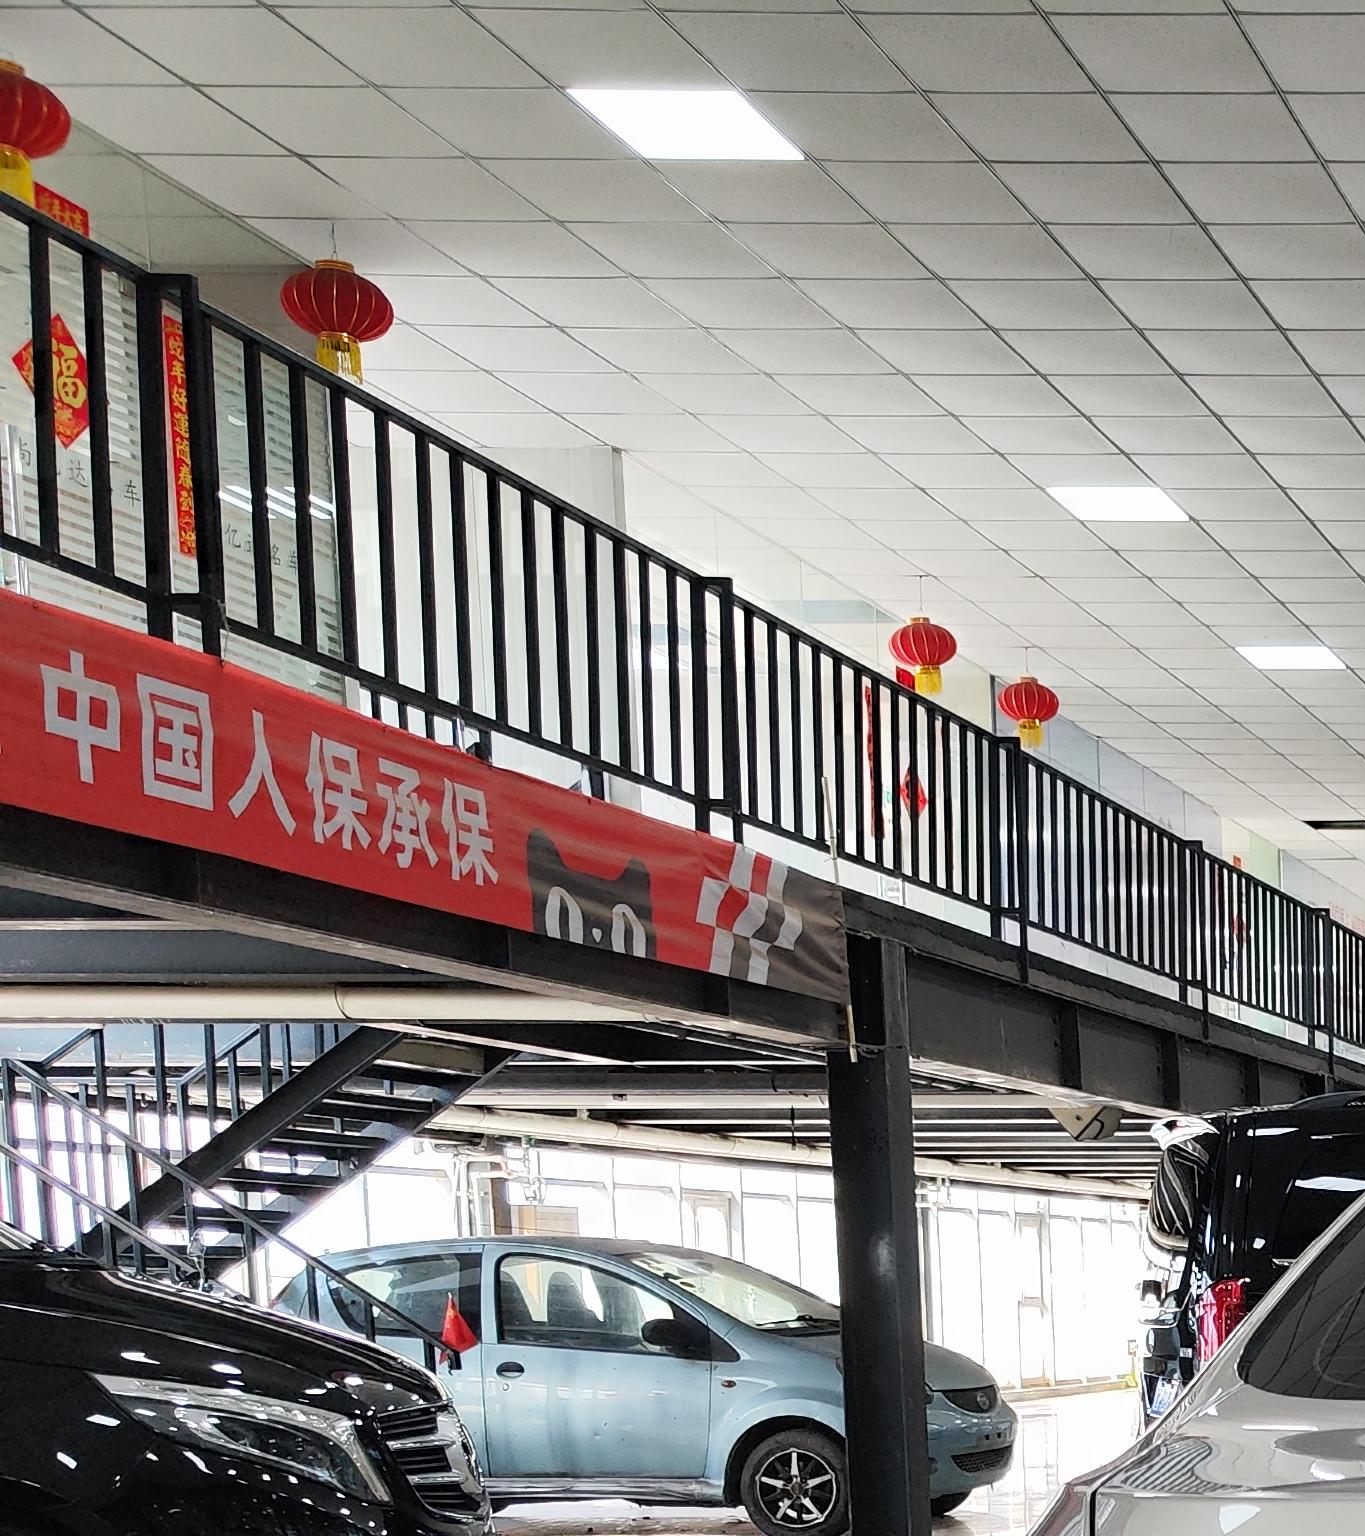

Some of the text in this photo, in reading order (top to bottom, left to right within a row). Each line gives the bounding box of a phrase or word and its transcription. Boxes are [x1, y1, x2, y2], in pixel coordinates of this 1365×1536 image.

[41, 649, 500, 888] 中国人保承保
